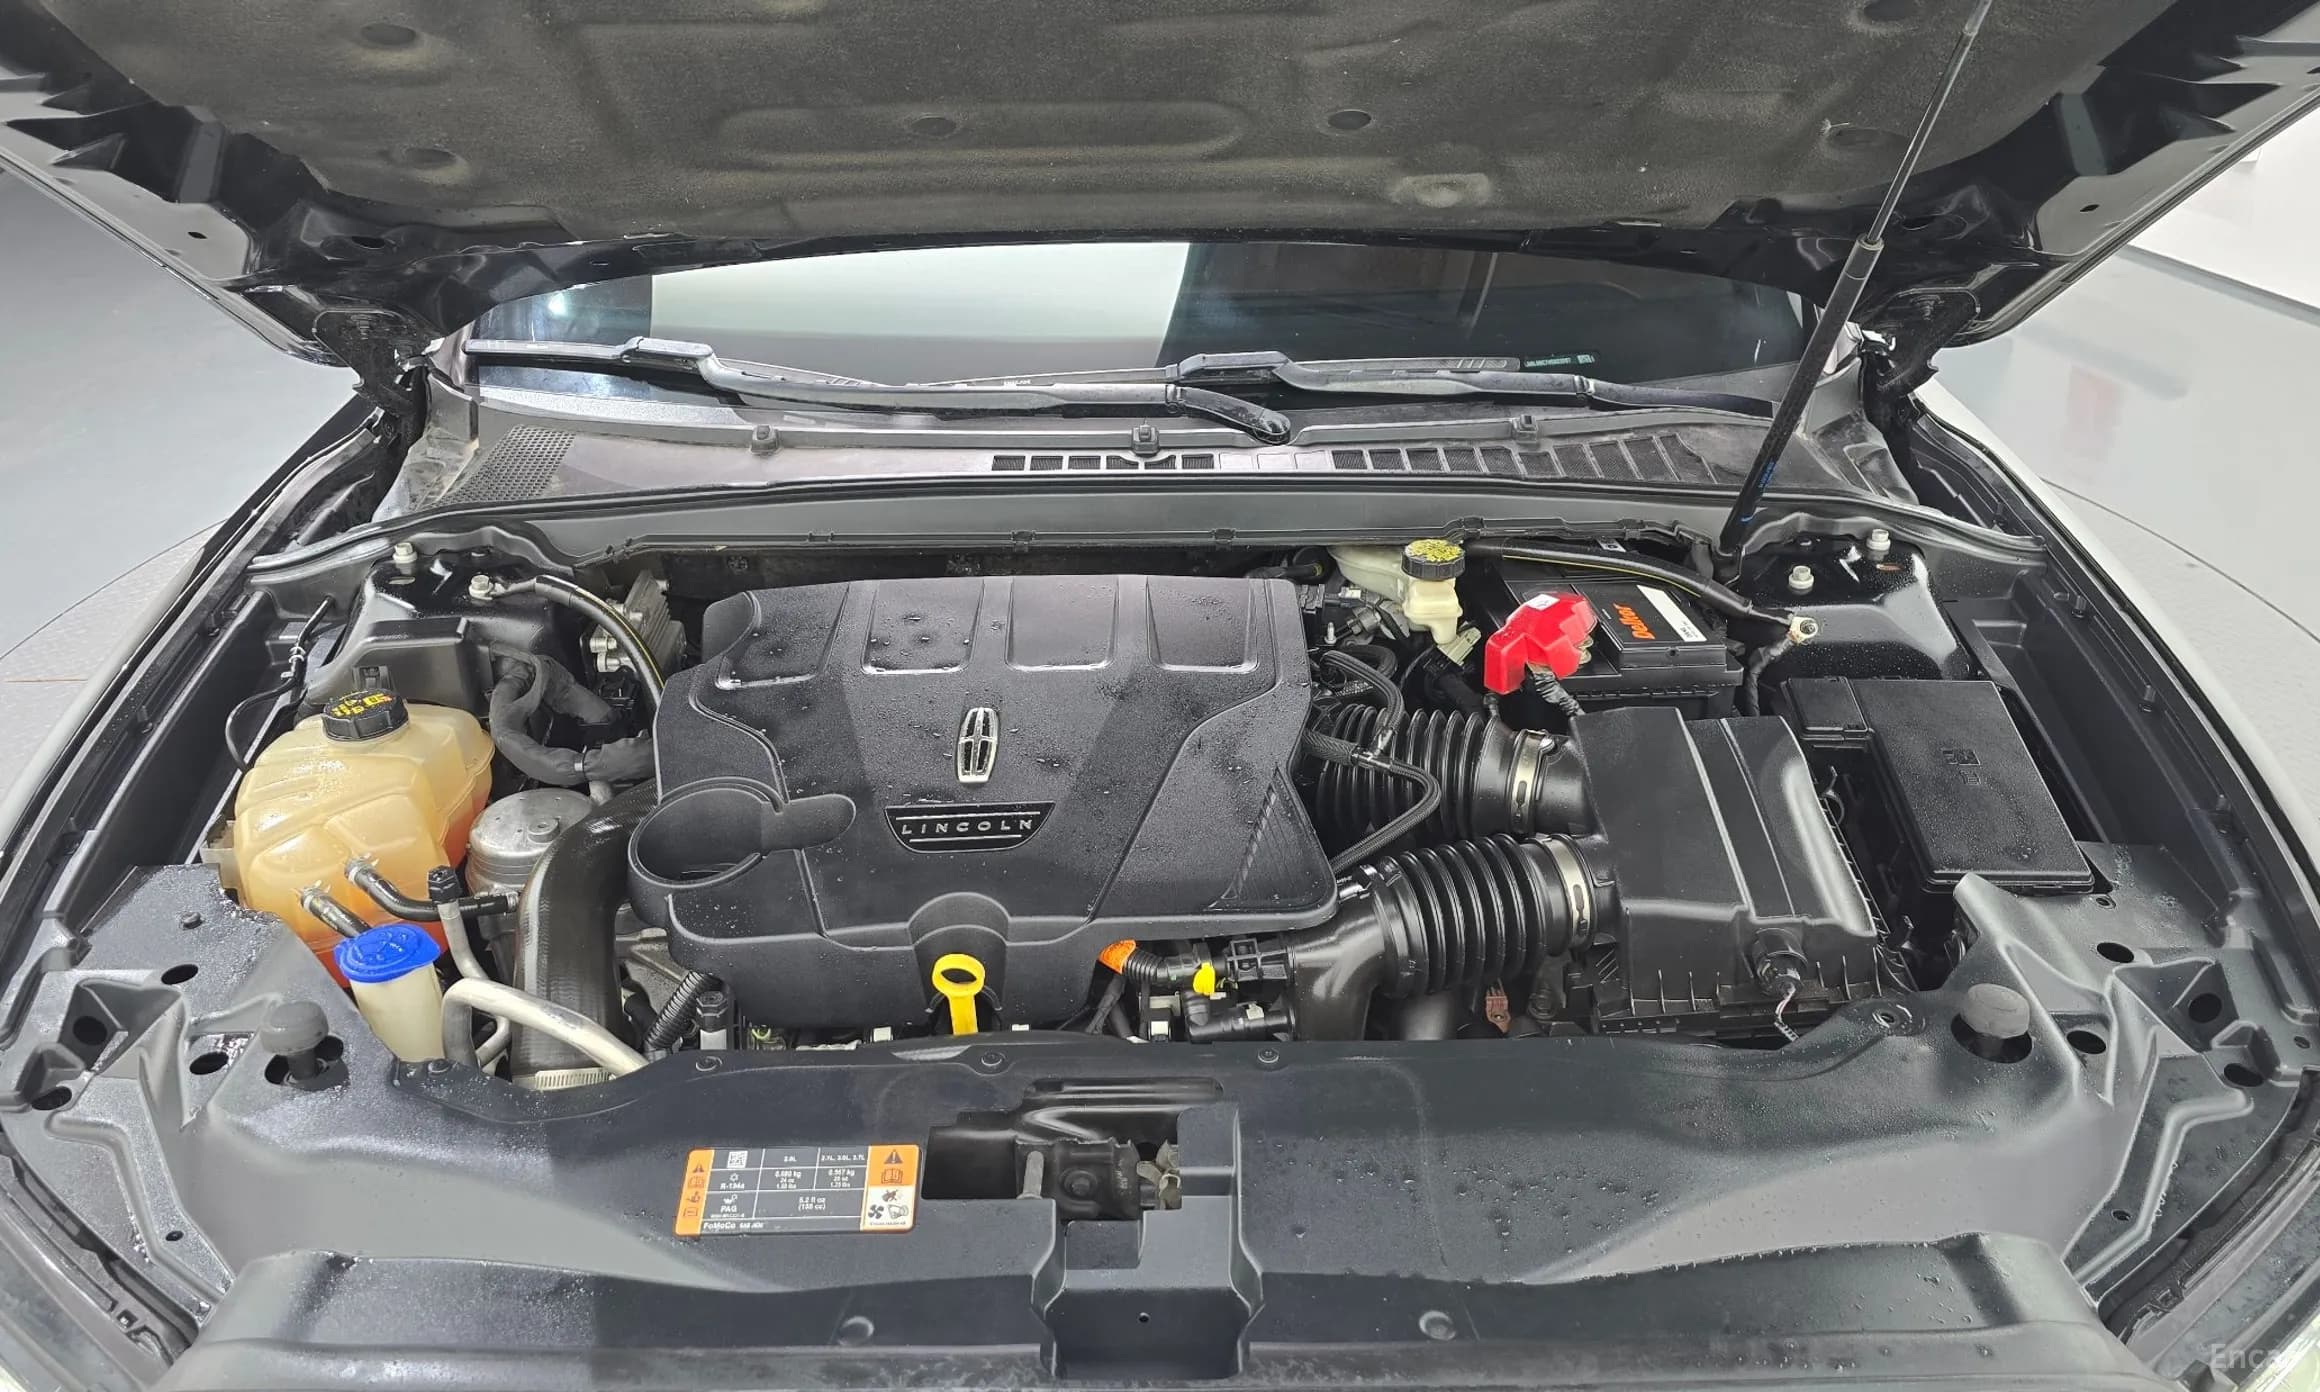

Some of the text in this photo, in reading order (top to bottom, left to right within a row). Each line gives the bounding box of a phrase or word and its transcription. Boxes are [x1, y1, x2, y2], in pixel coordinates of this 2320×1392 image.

[901, 819, 1033, 835] LINCOLN
[720, 1205, 737, 1213] PAG
[703, 1221, 736, 1229] FoMoCo
